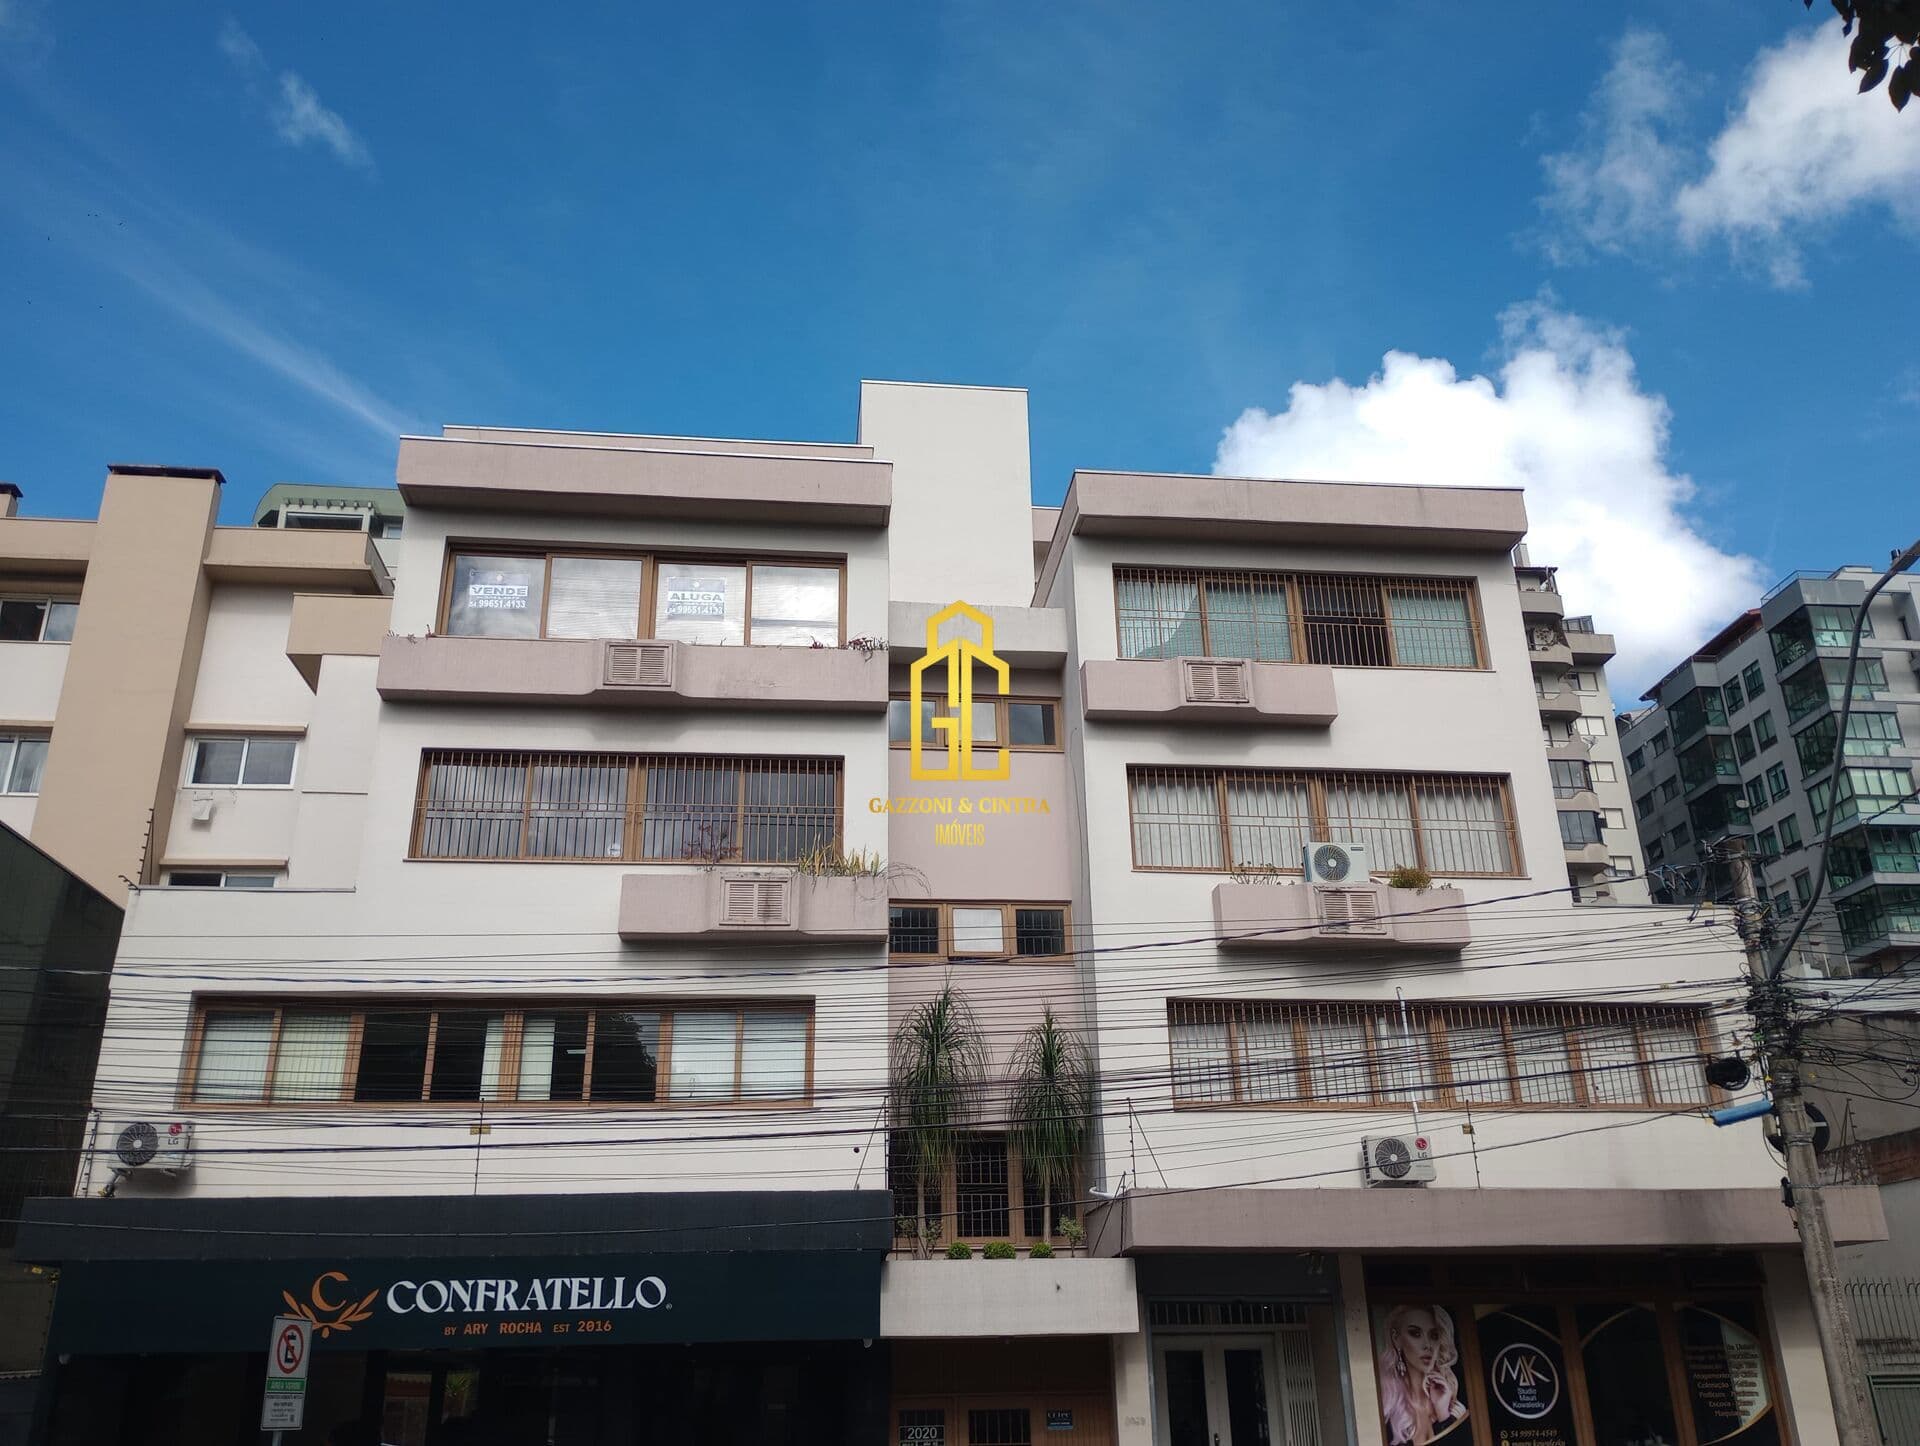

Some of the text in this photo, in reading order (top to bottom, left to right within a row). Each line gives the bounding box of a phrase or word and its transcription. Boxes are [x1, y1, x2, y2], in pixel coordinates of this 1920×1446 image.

[471, 586, 527, 596] VENDE
[670, 593, 723, 602] ALUGA
[386, 1276, 667, 1314] CONFRATELLO
[444, 1320, 613, 1336] BY ARY ROCHA EST 2016
[907, 1427, 937, 1439] 2020
